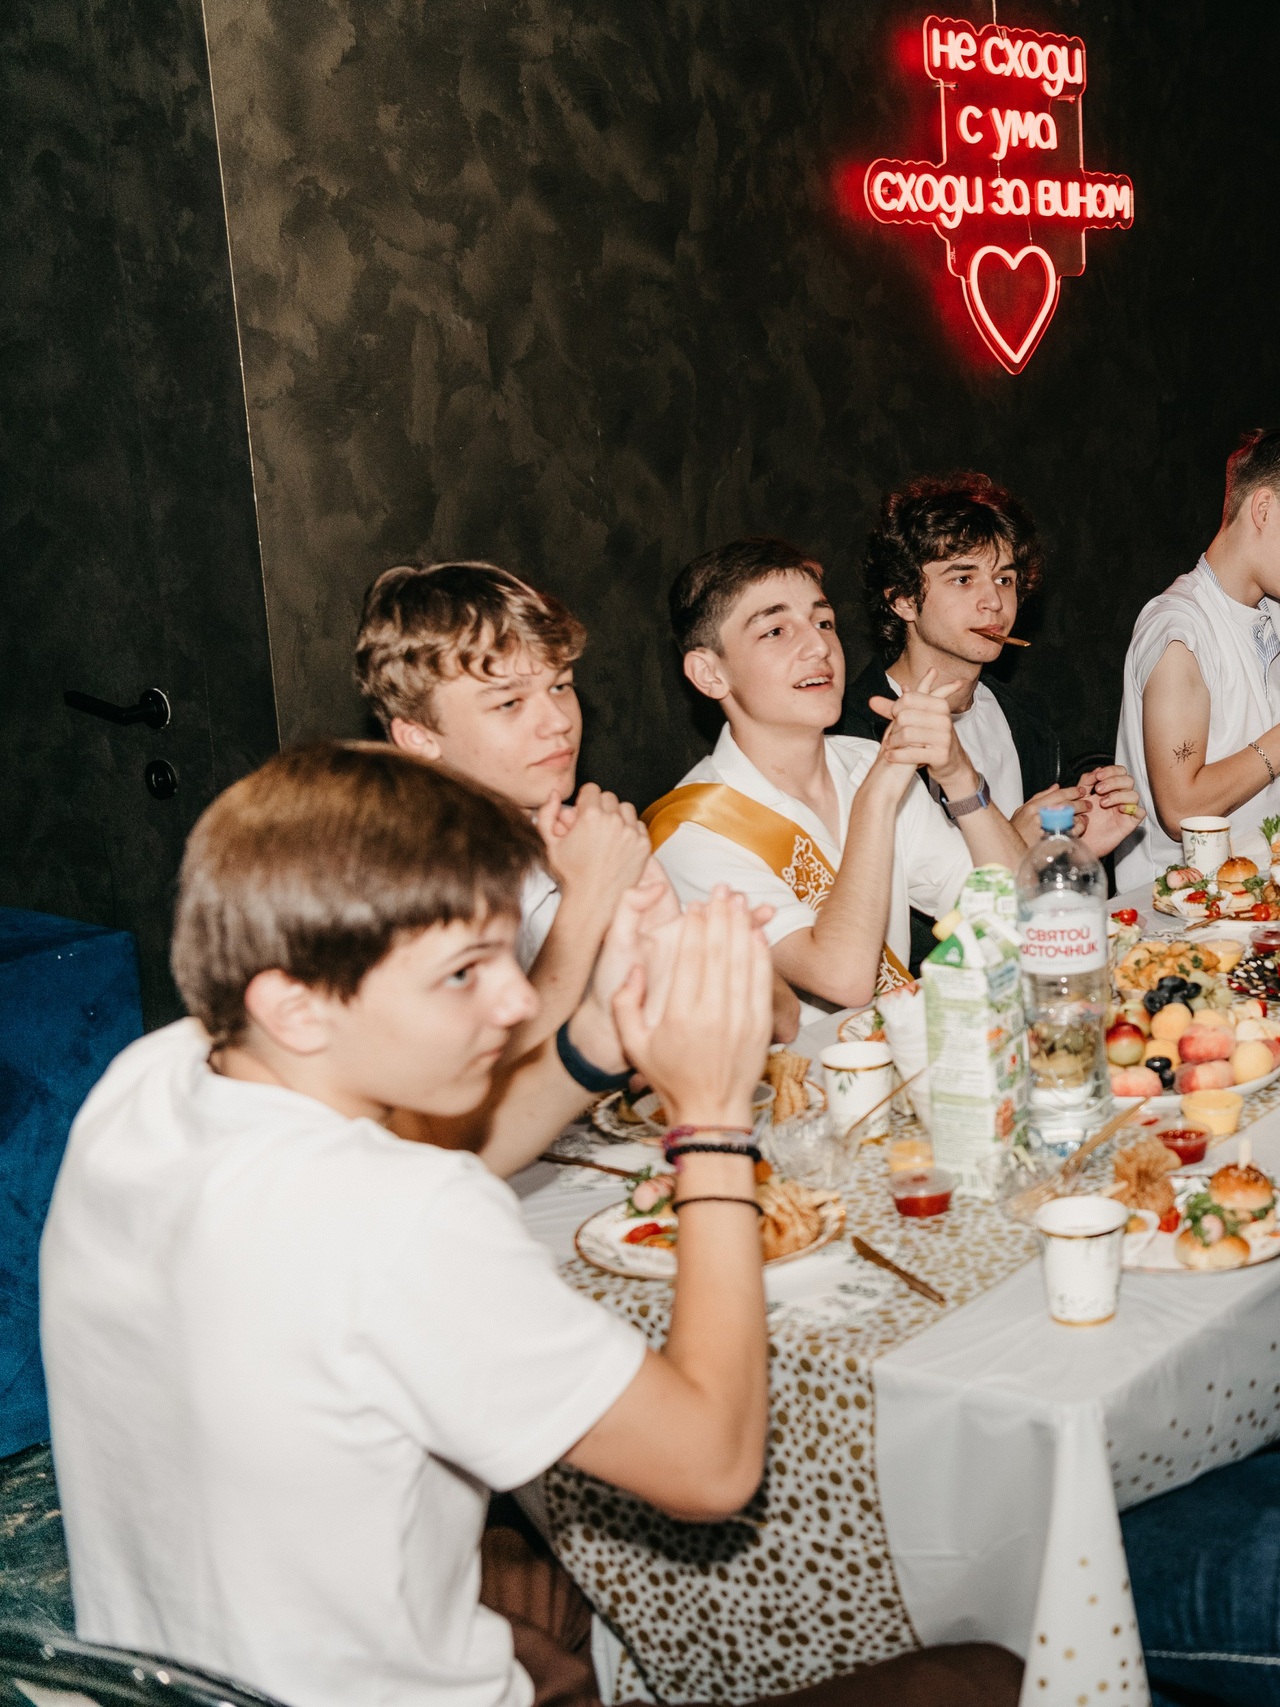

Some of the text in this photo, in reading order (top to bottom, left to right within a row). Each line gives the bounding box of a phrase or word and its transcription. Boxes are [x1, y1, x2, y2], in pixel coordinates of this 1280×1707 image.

[931, 28, 1084, 97] Не сходи
[990, 107, 1058, 161] ума
[872, 171, 1131, 229] сходи за вином
[1026, 924, 1091, 942] СВЯТОЙ
